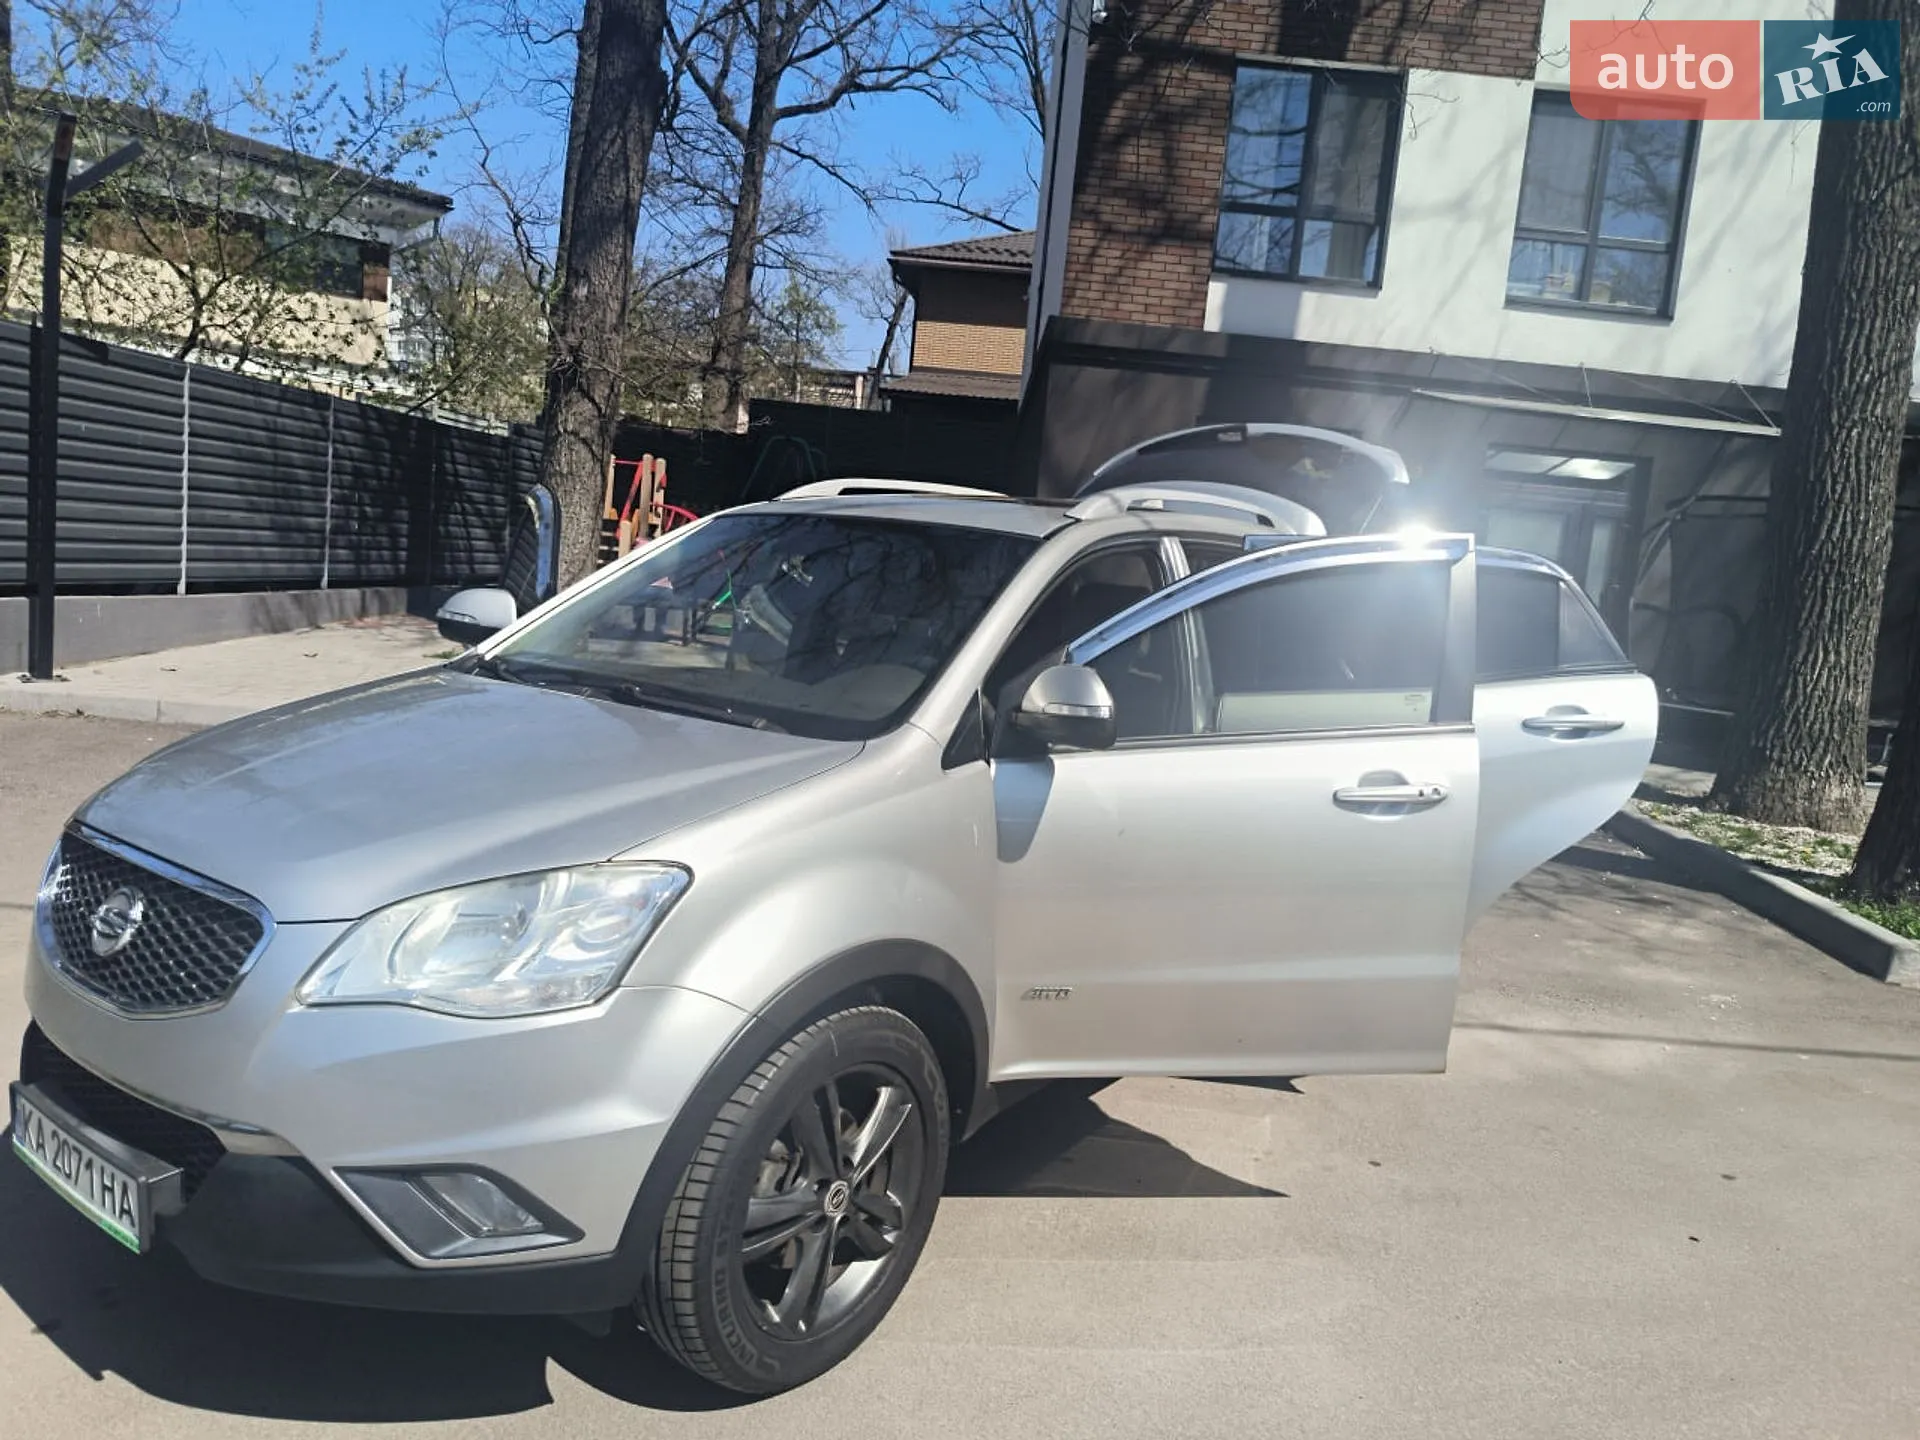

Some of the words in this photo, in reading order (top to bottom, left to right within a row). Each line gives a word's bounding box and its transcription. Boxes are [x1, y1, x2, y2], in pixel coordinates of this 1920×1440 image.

[22, 1103, 49, 1161] KA
[51, 1129, 96, 1201] 2071
[101, 1165, 136, 1229] HA
